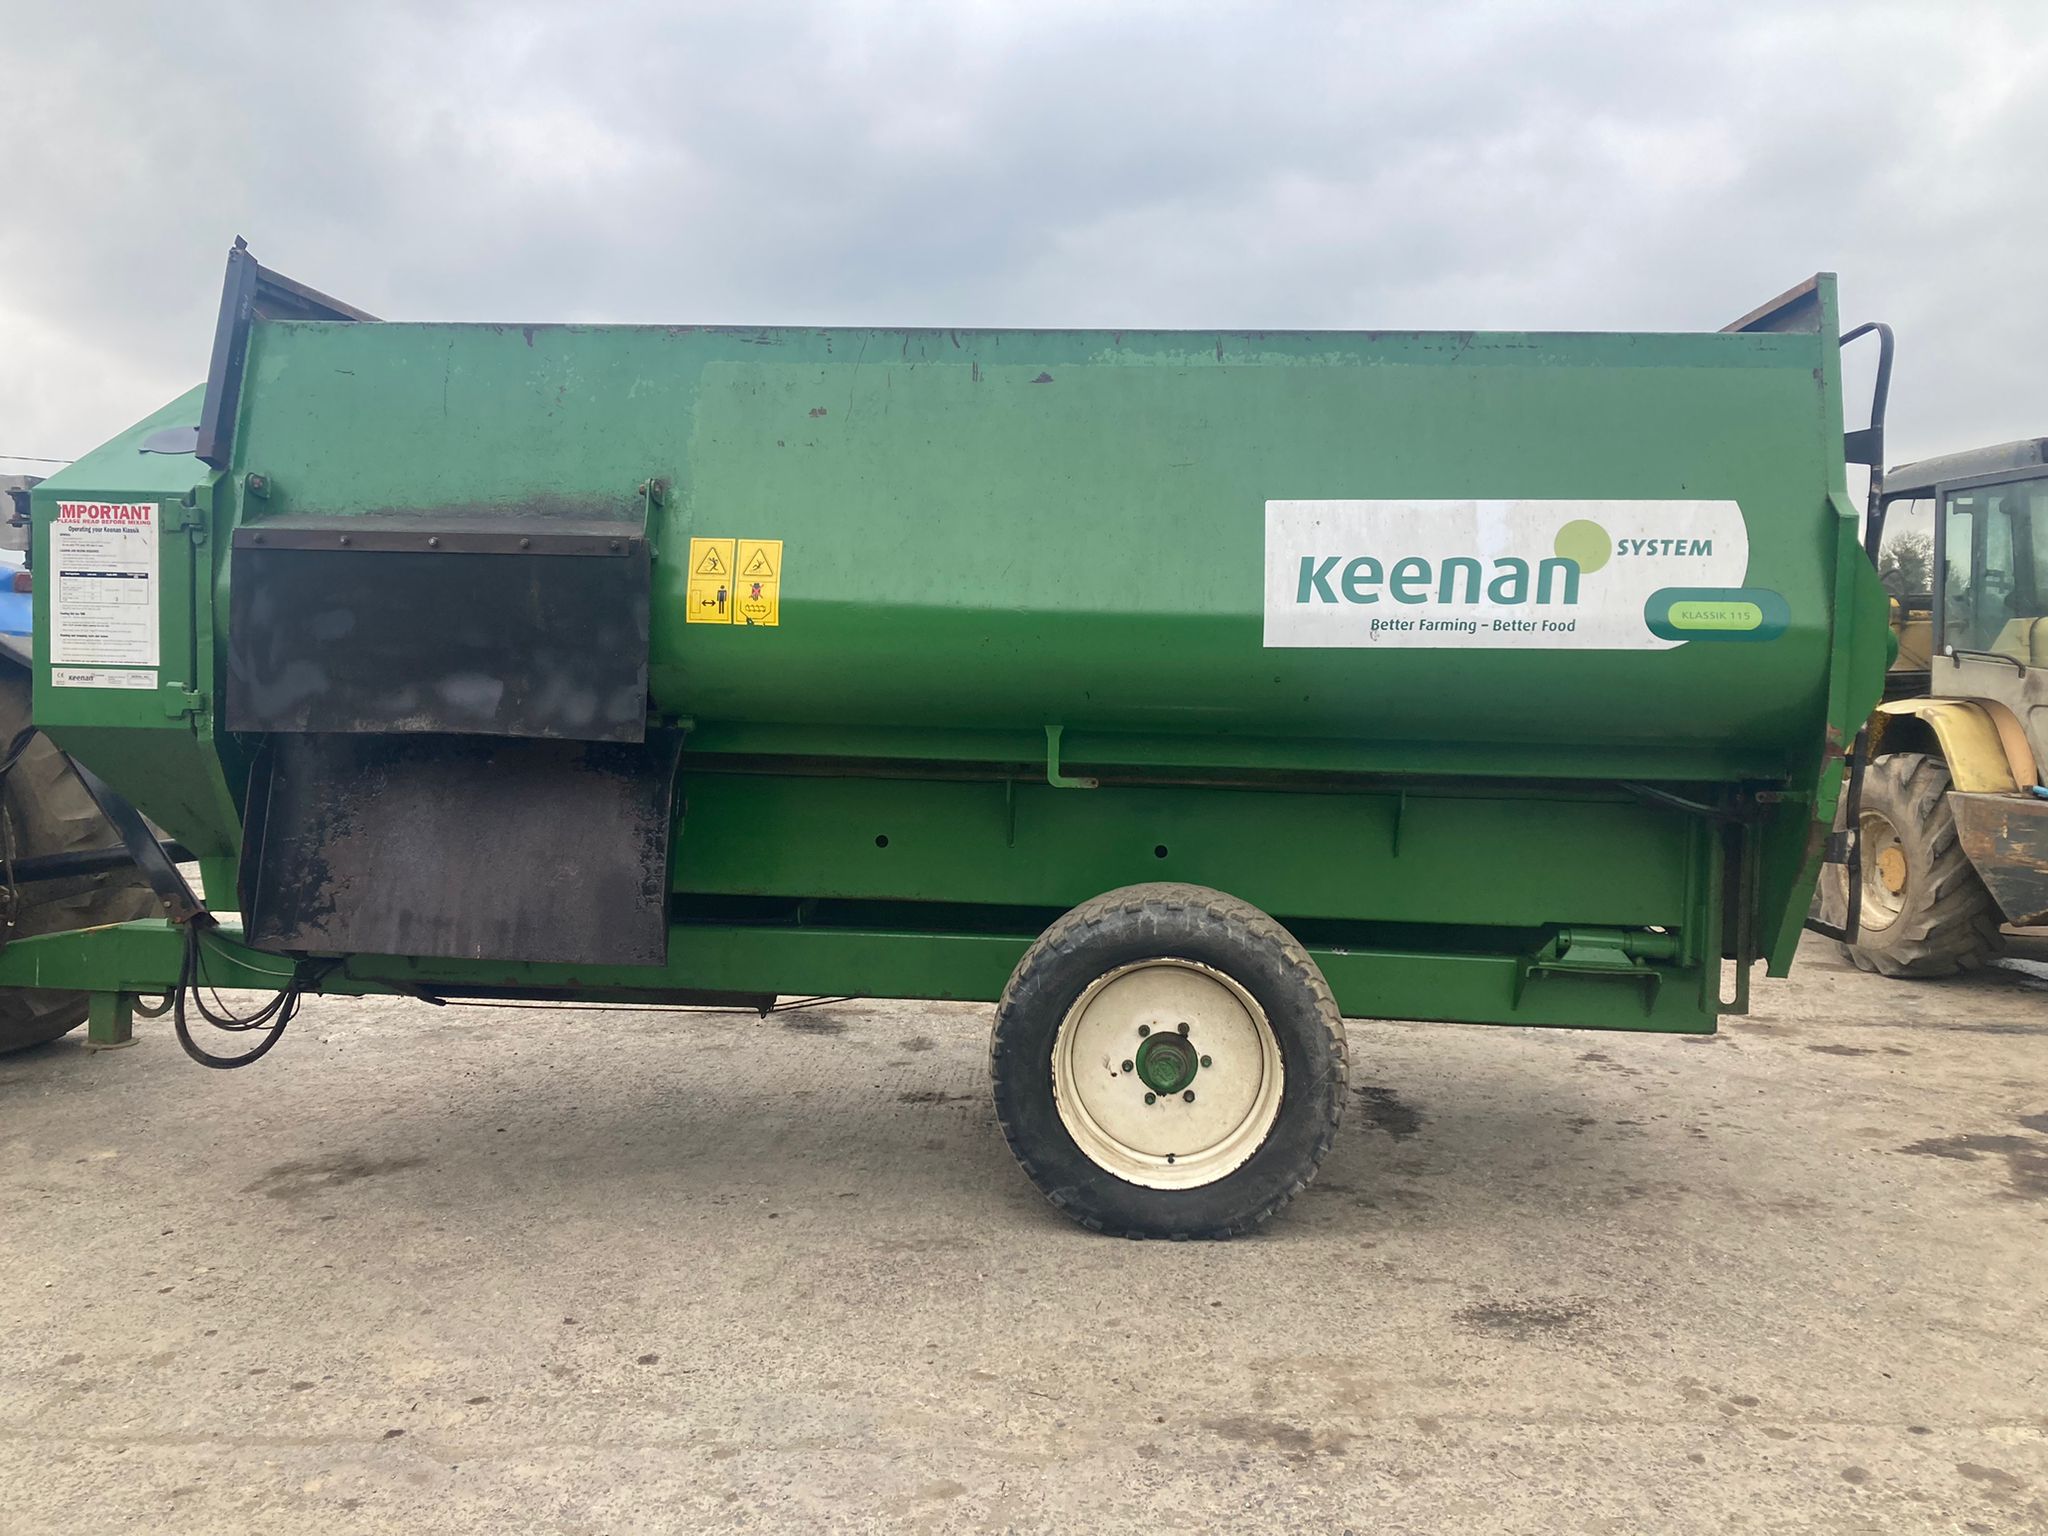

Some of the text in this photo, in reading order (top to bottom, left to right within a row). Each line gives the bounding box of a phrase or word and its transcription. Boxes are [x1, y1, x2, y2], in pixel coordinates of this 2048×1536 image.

[1617, 539, 1713, 557] SYSTEM
[1682, 612, 1751, 621] KLASSIK 115
[1371, 619, 1413, 632] Better
[1419, 619, 1477, 634] Farming
[1493, 619, 1537, 632] Better
[1542, 619, 1576, 632] Food
